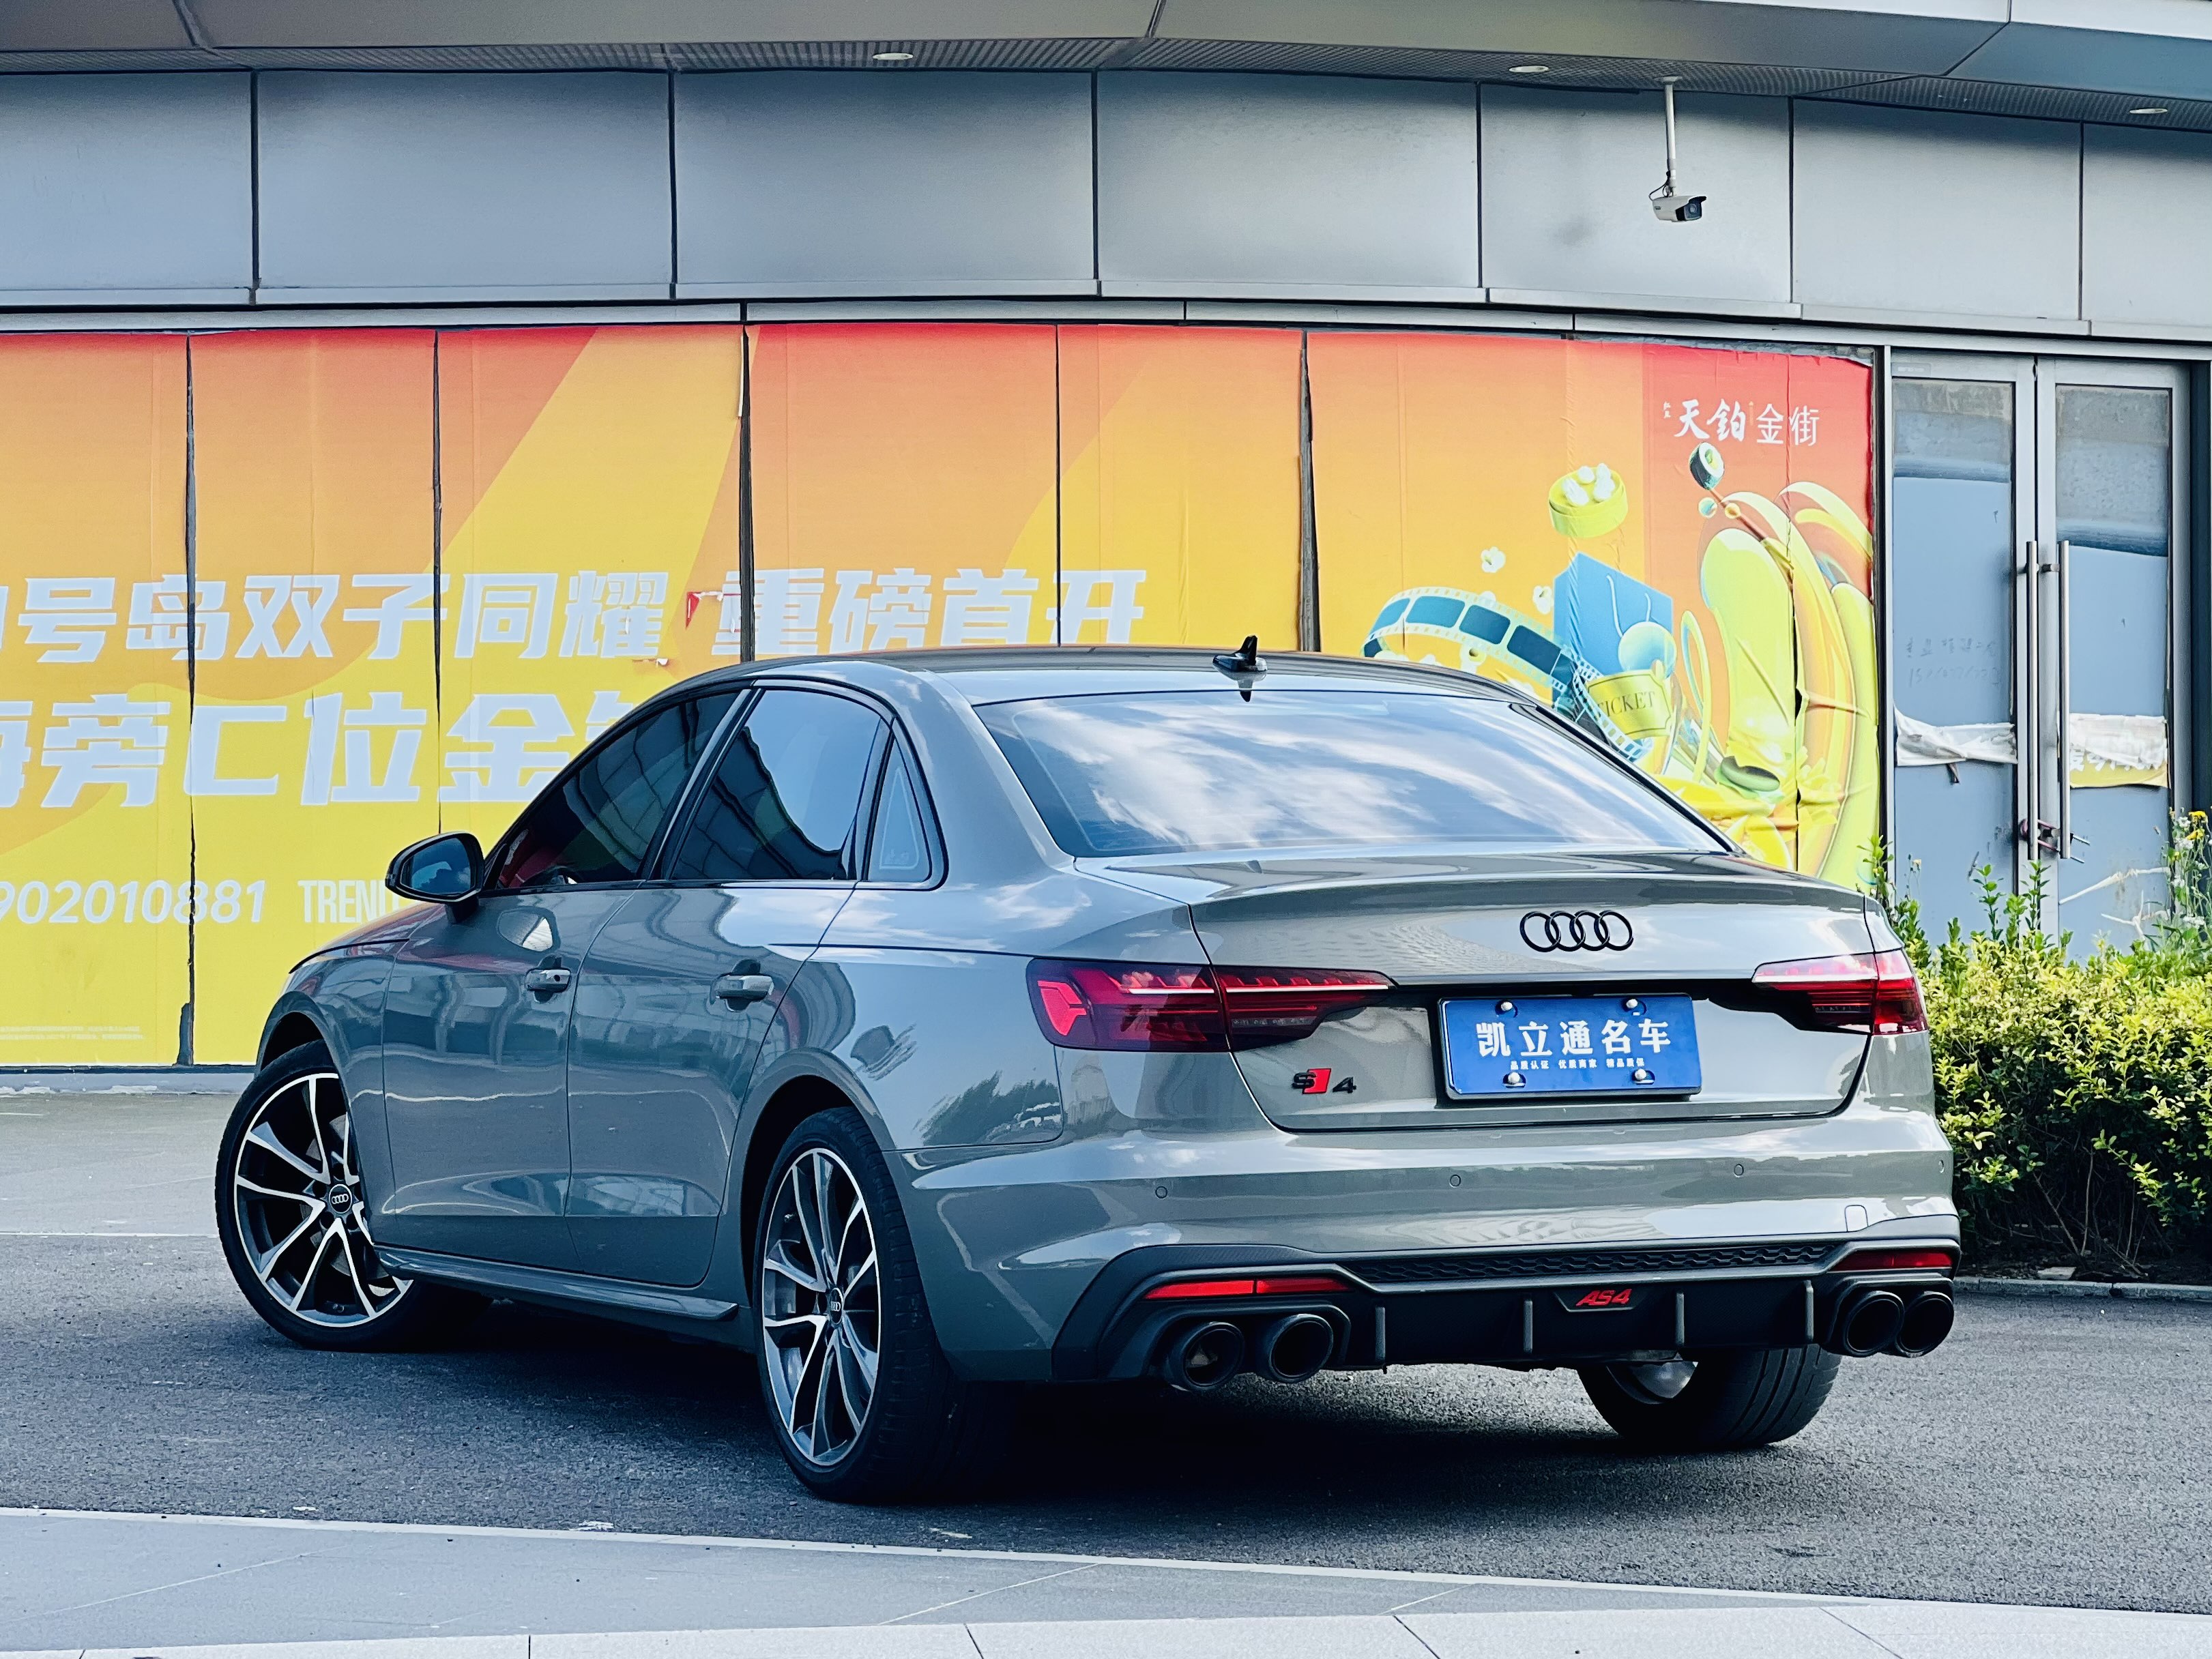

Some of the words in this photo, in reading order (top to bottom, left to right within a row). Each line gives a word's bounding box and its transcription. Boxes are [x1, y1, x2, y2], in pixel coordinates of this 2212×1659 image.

[0, 570, 669, 662] 号岛双子同耀
[711, 568, 1147, 656] 重磅首开
[0, 691, 633, 808] 旁C位金
[1476, 1018, 1671, 1057] 凯立通名车
[1575, 1289, 1633, 1306] AS4
